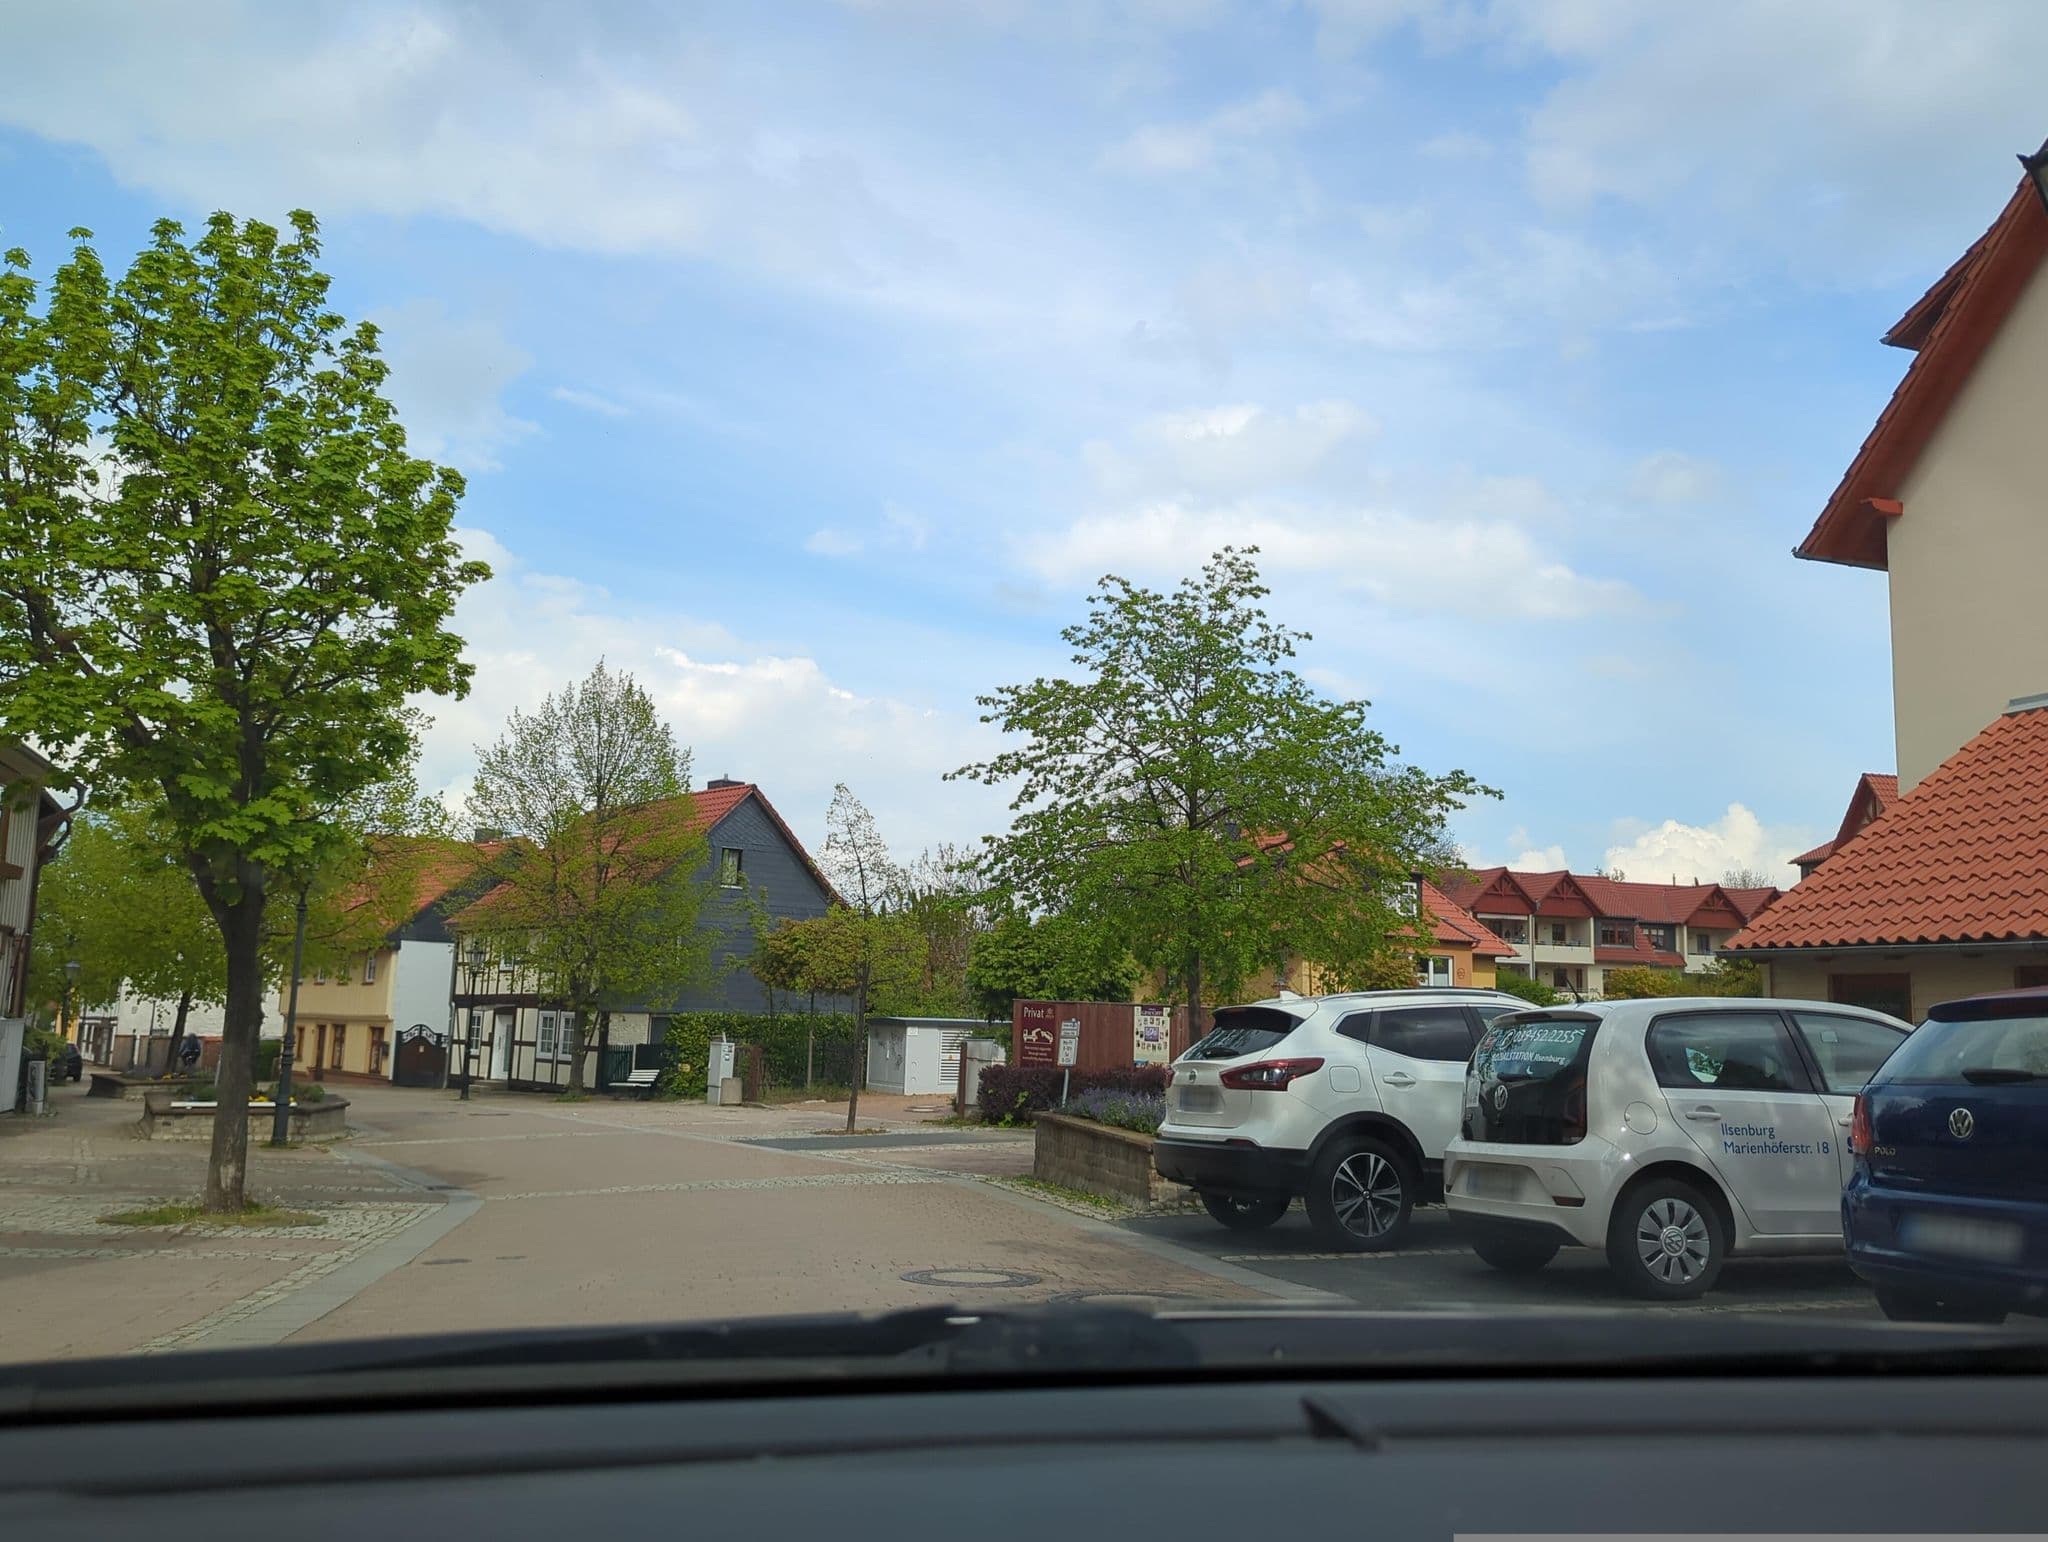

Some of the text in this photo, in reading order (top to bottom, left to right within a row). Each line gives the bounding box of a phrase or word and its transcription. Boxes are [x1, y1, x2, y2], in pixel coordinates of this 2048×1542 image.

[1023, 1006, 1044, 1019] Privat
[1721, 1123, 1775, 1139] Ilsenburg
[1724, 1140, 1829, 1154] Marienhöferstr. 18
